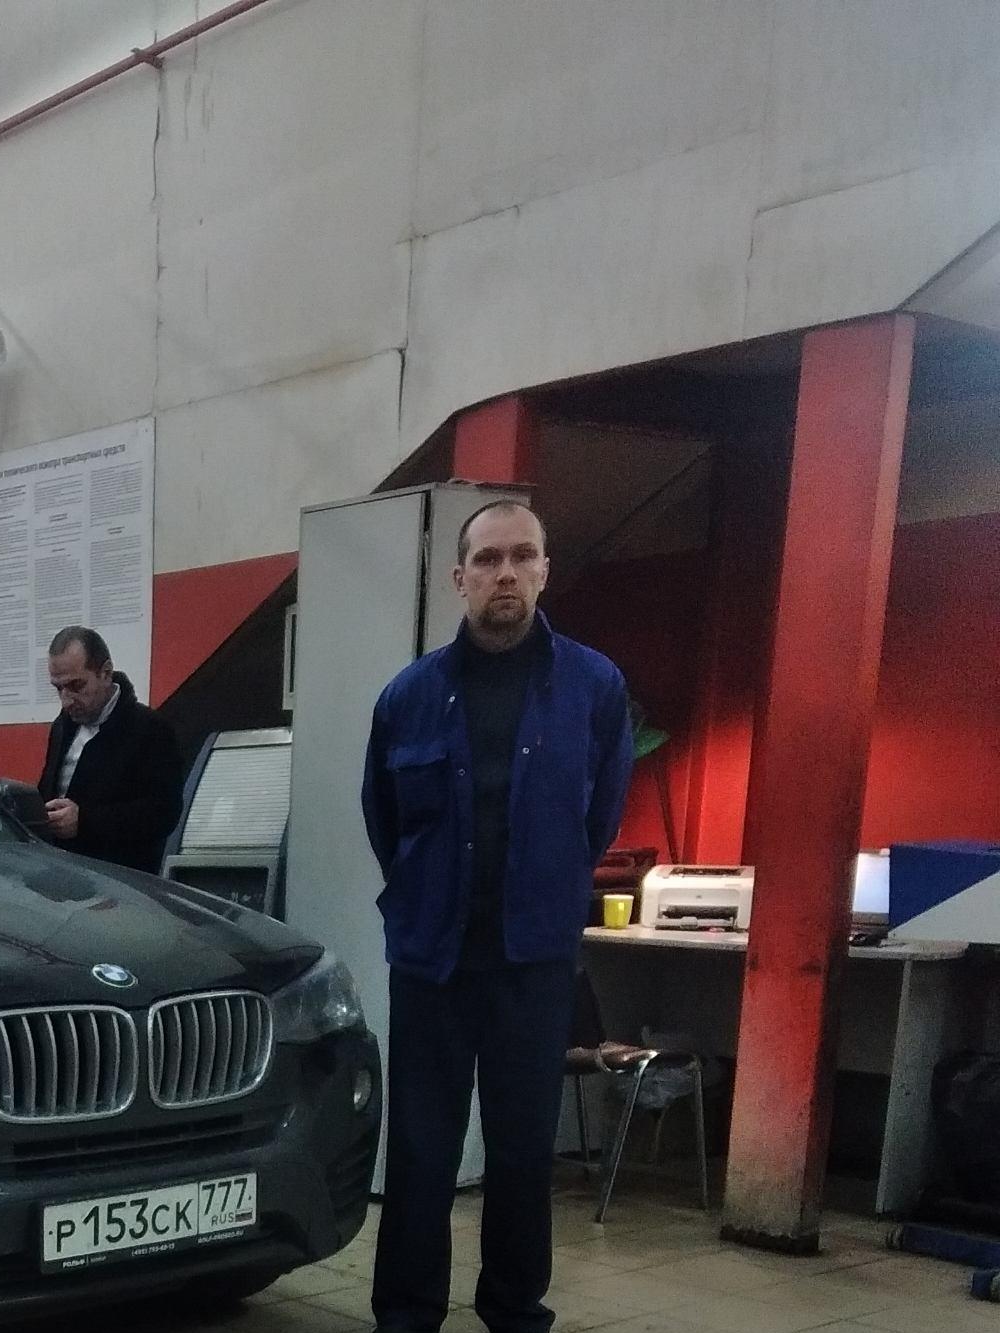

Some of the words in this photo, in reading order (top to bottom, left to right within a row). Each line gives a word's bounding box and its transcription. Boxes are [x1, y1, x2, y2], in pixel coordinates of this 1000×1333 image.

[201, 1177, 247, 1215] 777
[56, 1197, 193, 1253] Р153СК
[210, 1212, 235, 1227] RUS
